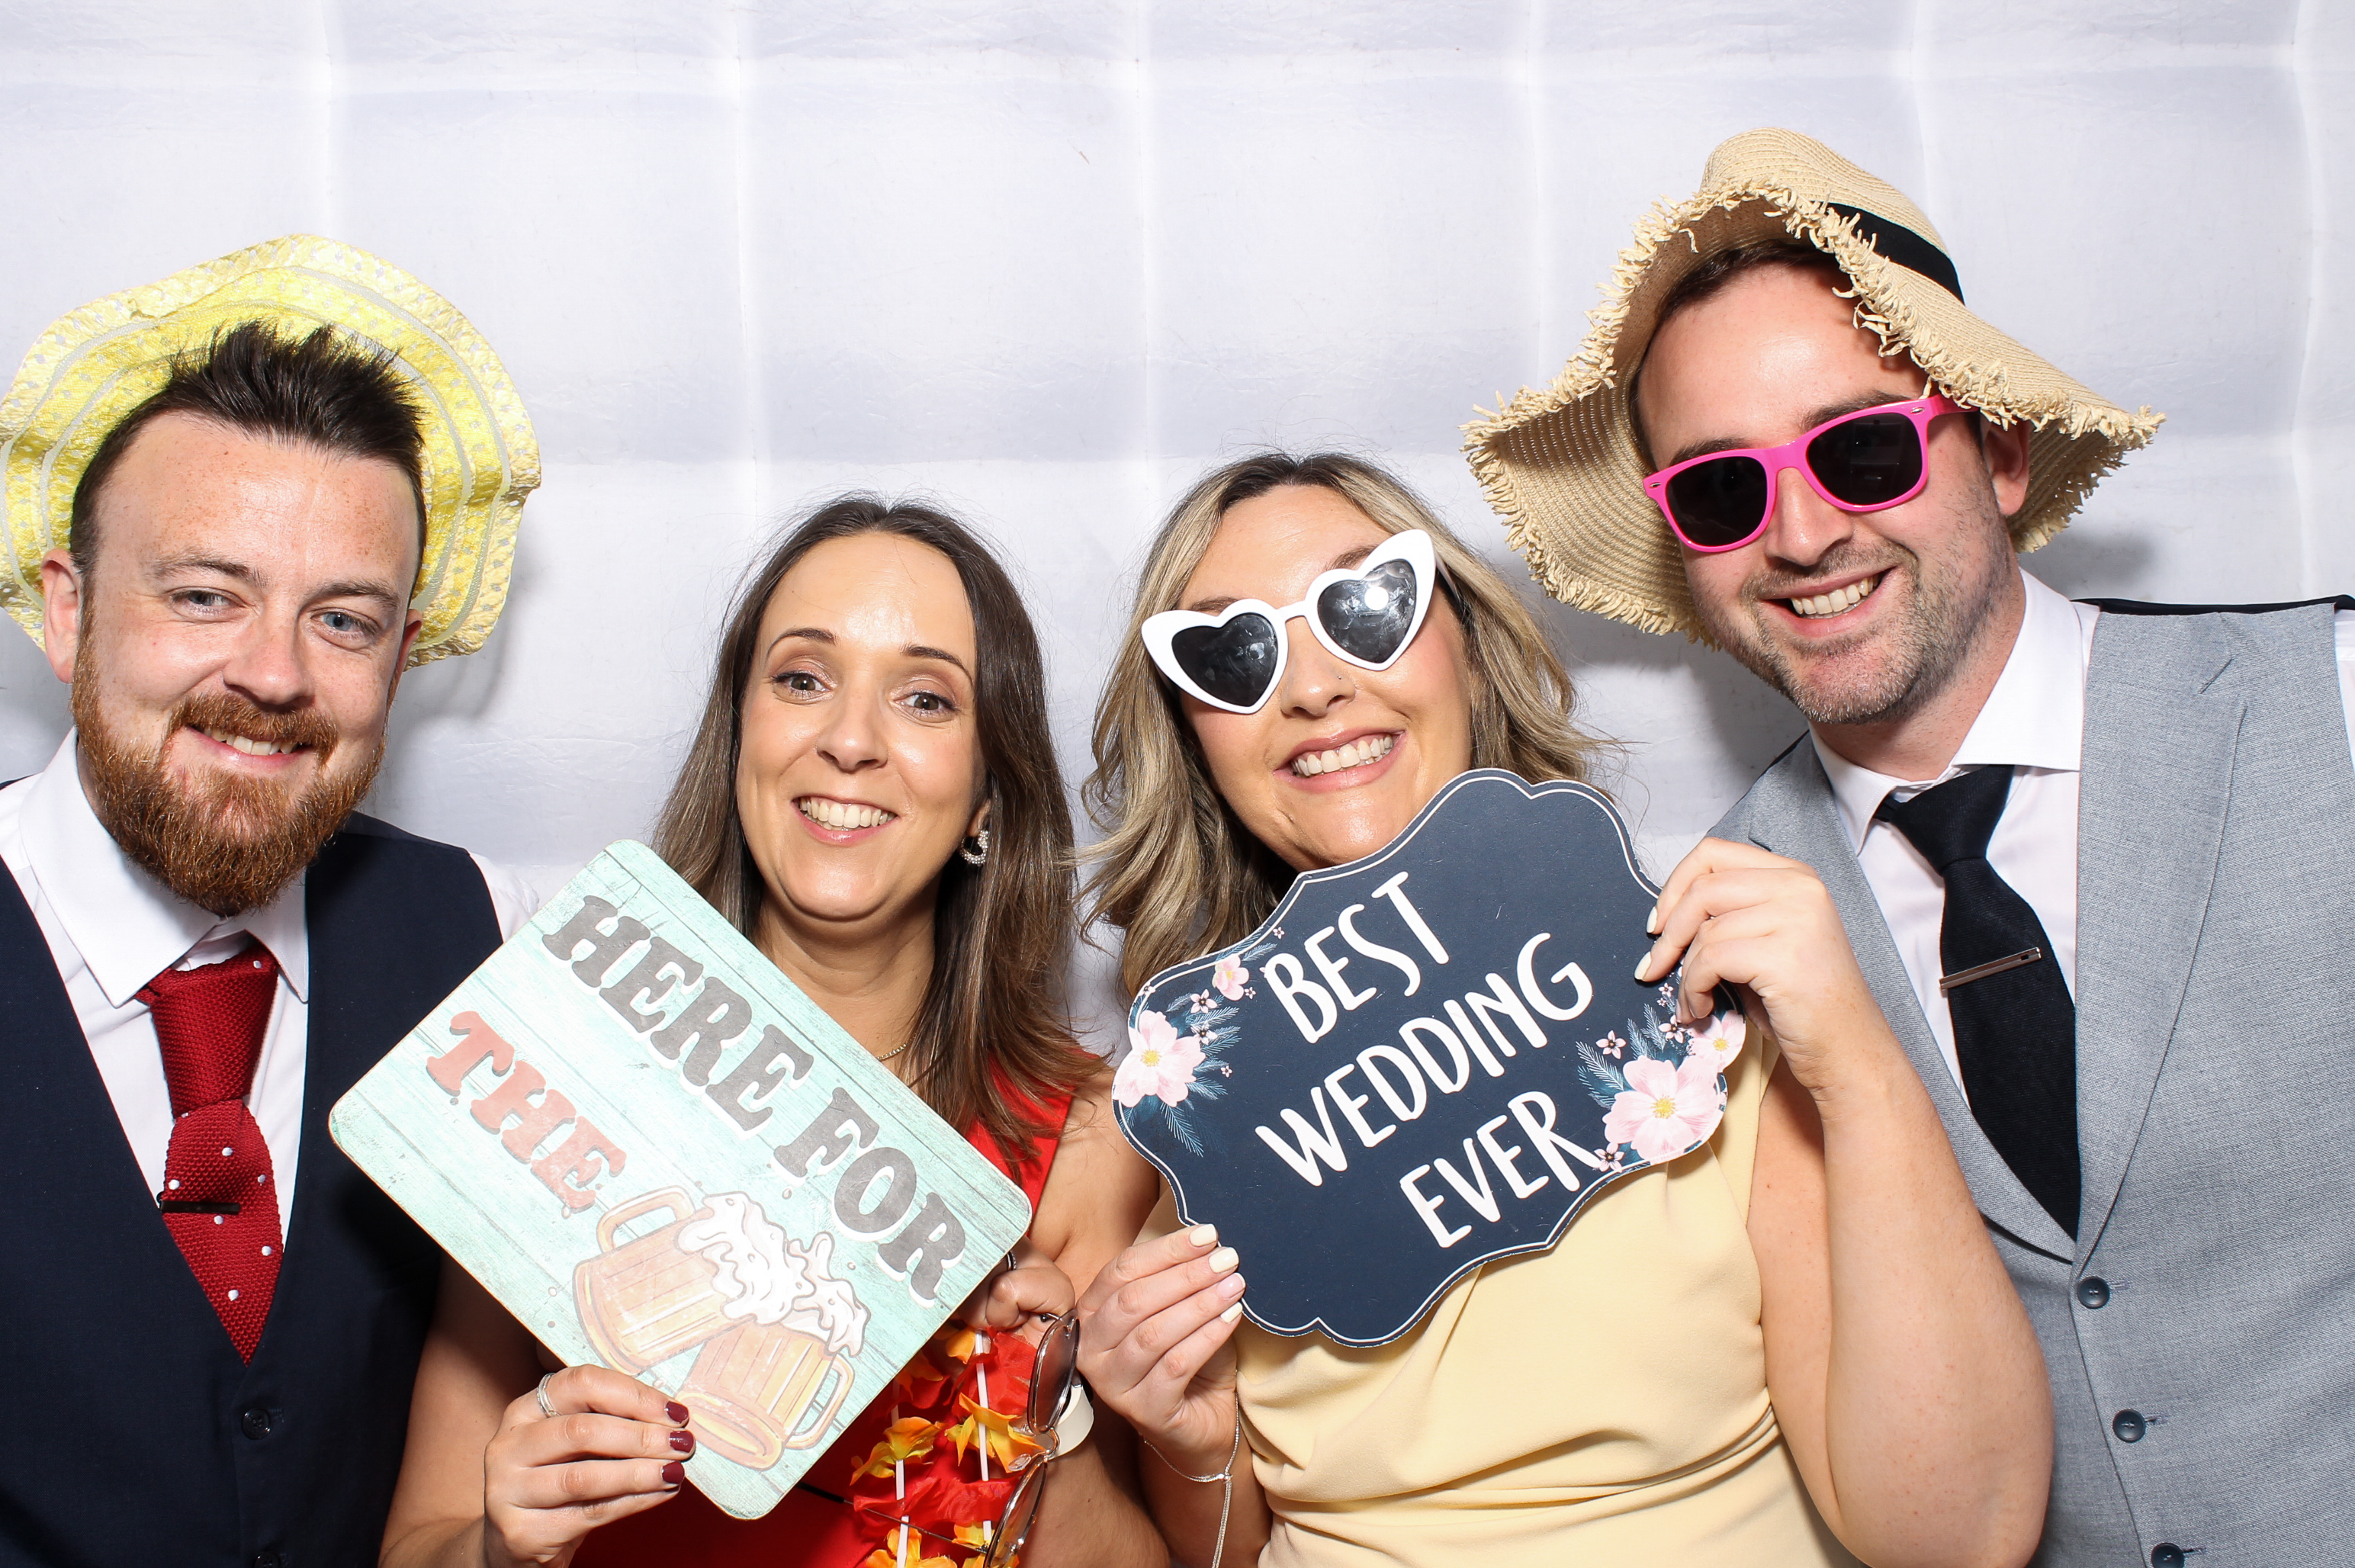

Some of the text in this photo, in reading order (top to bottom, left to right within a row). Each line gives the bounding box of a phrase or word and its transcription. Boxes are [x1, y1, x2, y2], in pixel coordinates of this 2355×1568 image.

[1264, 871, 1449, 1044] BEST
[426, 1011, 625, 1212] THE
[541, 895, 966, 1307] HERE FOR
[1255, 933, 1593, 1187] WEDDING
[1399, 1091, 1601, 1248] EVER
